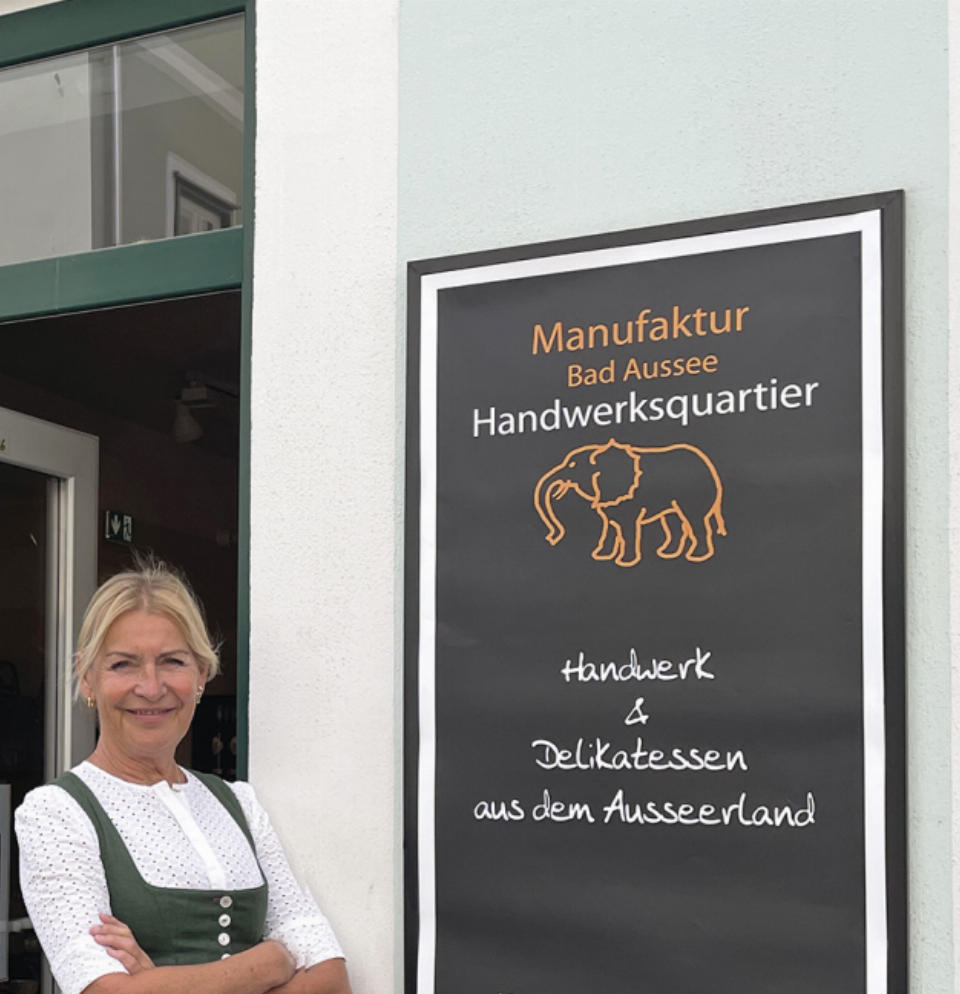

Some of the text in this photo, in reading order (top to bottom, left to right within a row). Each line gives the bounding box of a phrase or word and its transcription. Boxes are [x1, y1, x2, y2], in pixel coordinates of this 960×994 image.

[532, 306, 749, 354] Manufaktur
[568, 355, 718, 386] Bad Aussee
[473, 378, 819, 437] Handwerksquartier
[561, 648, 714, 682] Handwerk
[625, 698, 648, 725] &
[532, 737, 747, 770] Delikatessen
[474, 789, 815, 826] aus dem Ausseerland
